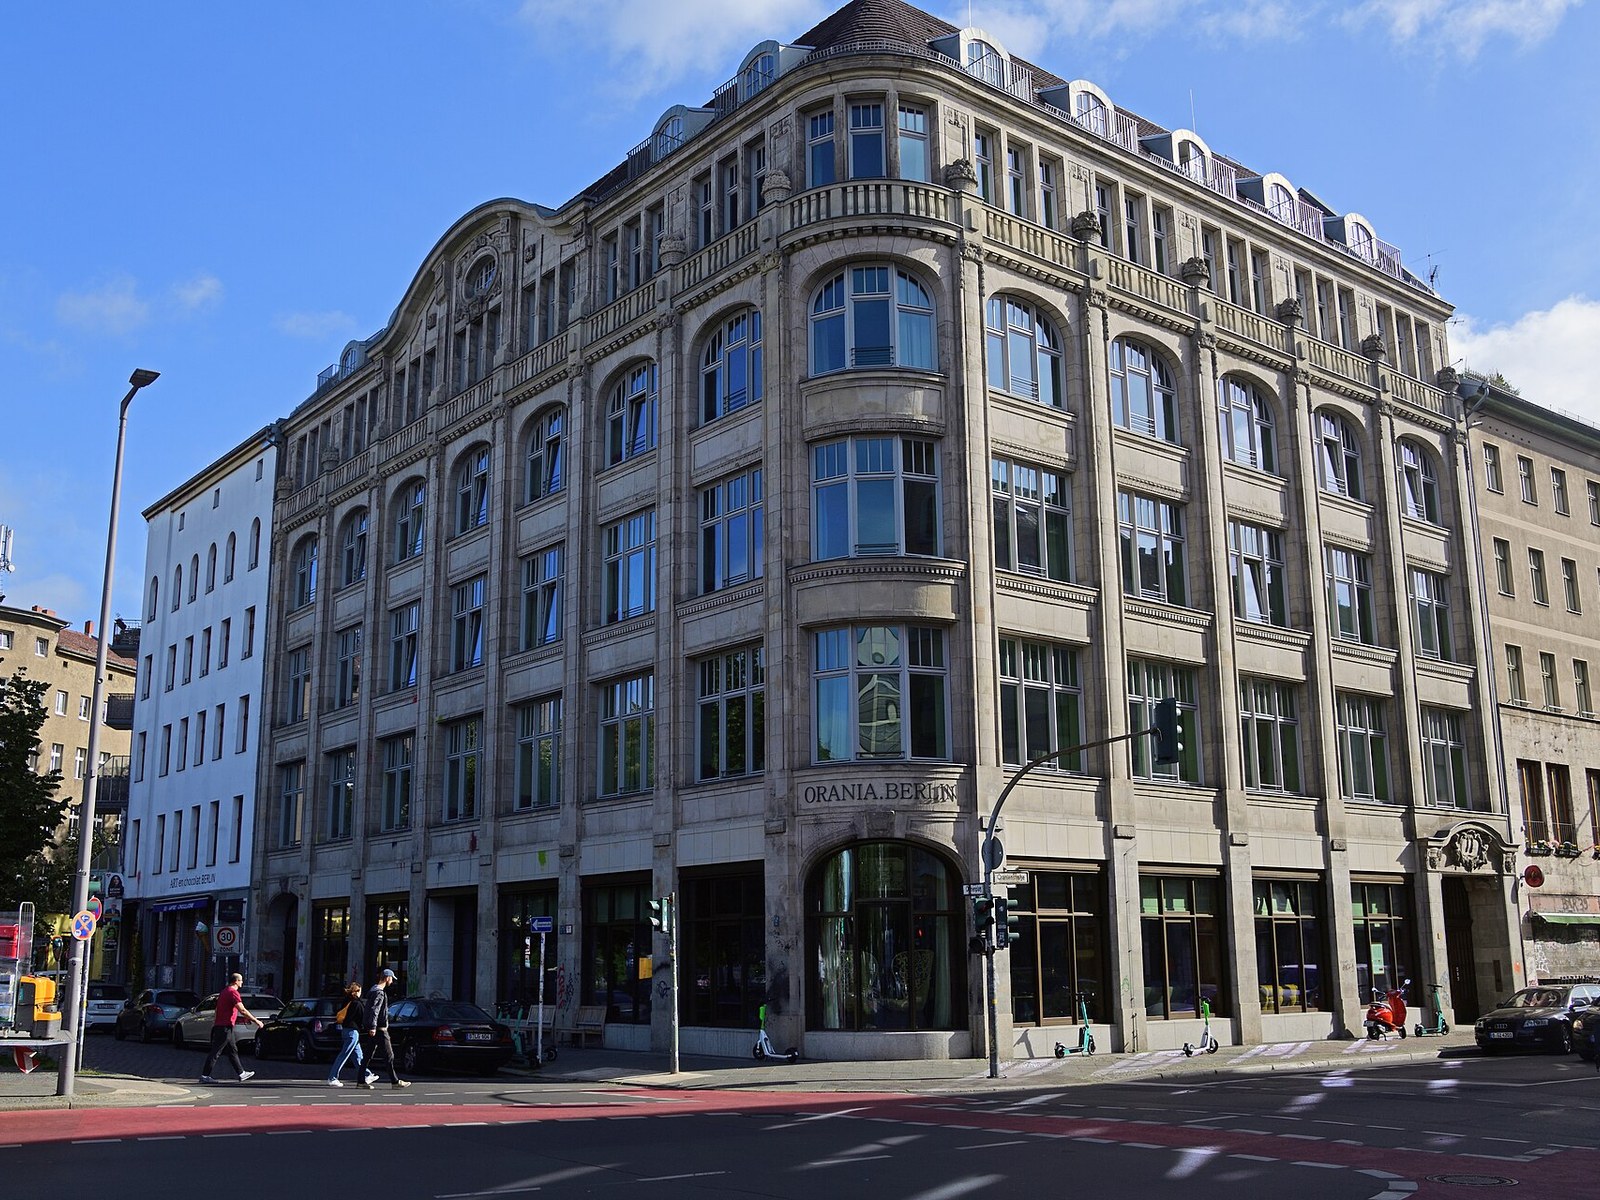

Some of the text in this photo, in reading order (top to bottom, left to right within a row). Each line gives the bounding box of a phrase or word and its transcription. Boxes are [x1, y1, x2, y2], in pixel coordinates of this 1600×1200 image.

[804, 782, 957, 804] ORANIA.BERLIN
[201, 873, 216, 885] BERLIN
[220, 932, 232, 941] 30
